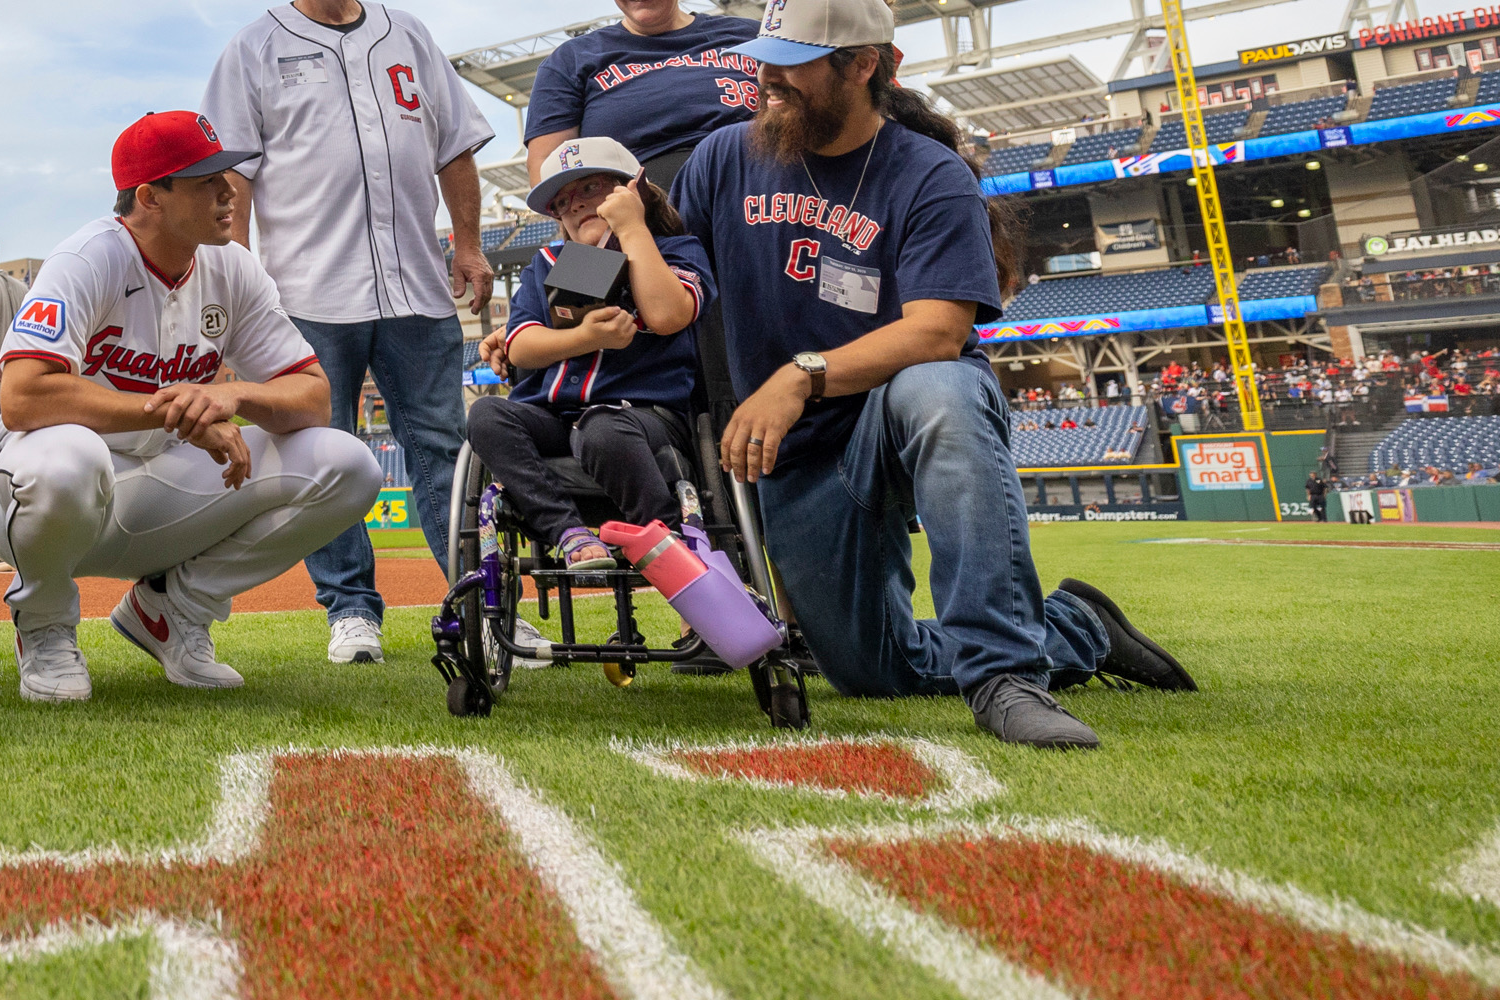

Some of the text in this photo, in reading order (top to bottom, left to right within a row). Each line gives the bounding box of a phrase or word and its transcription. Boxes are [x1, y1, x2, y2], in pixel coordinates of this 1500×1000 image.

[1359, 5, 1500, 48] PENNANT DI
[386, 64, 420, 111] C
[715, 77, 760, 112] 38
[196, 114, 217, 143] C
[744, 192, 880, 250] CLEVELAND
[1394, 229, 1500, 250] FAT HEAD
[785, 238, 820, 281] C
[21, 302, 58, 327] M
[205, 312, 220, 329] 21
[17, 320, 56, 337] Marathon
[1191, 443, 1246, 469] drug
[1199, 467, 1257, 482] mart
[1084, 510, 1177, 522] Dumpsters.com
[1280, 502, 1310, 516] 325
